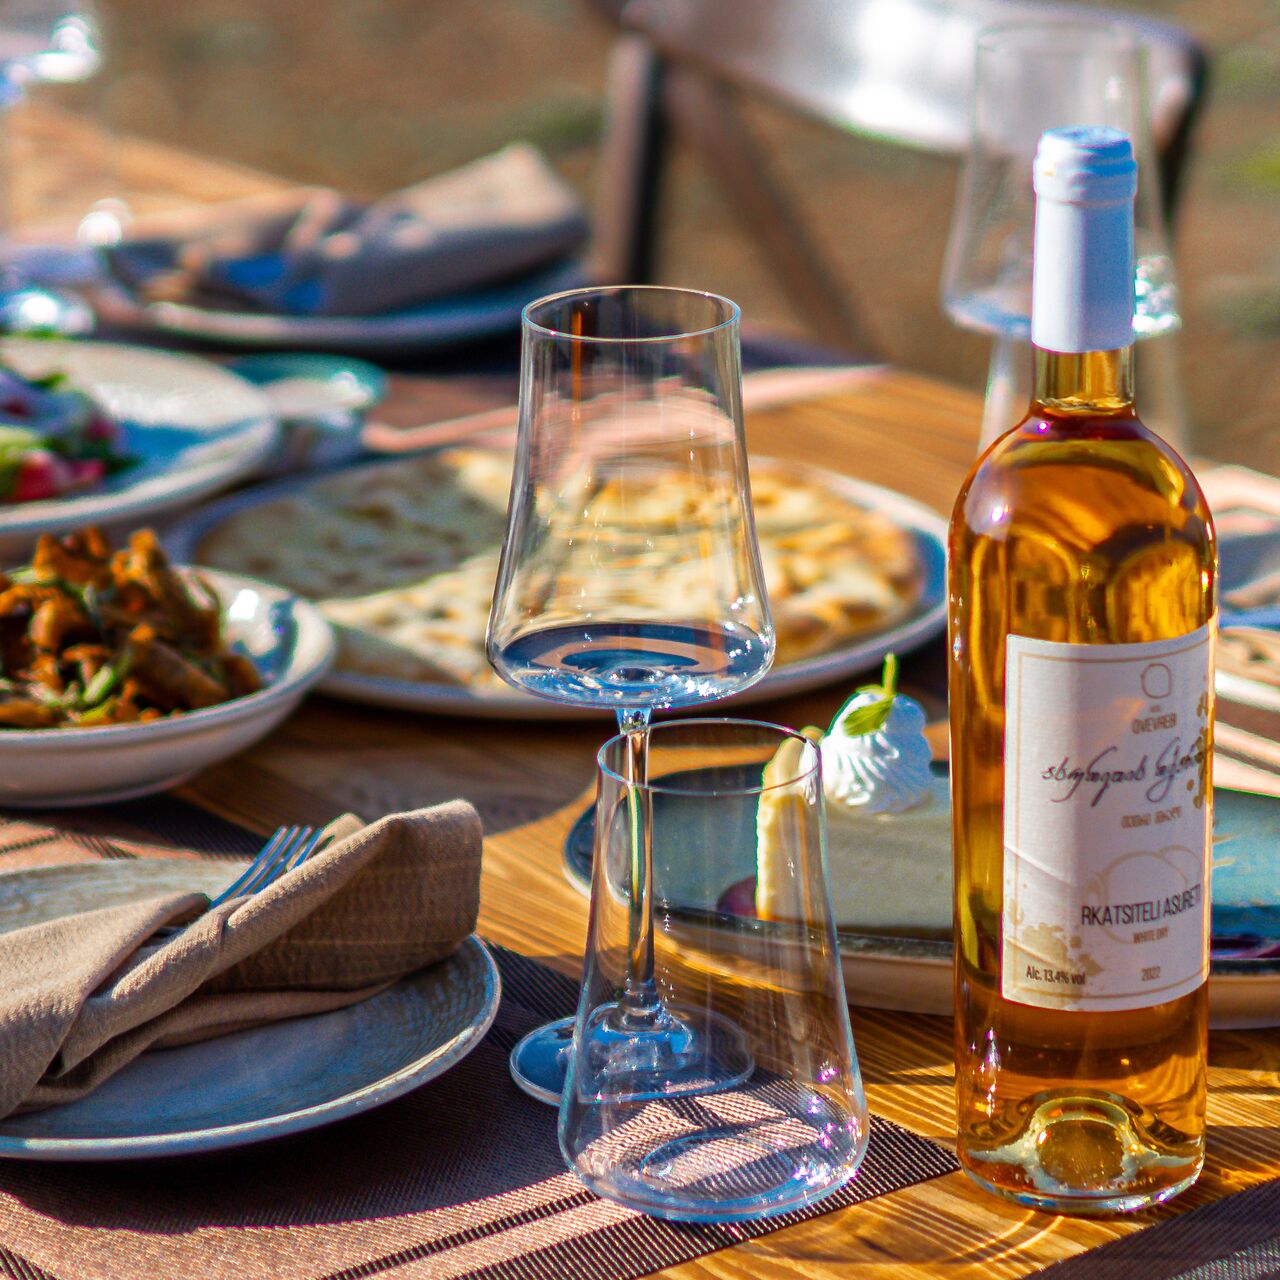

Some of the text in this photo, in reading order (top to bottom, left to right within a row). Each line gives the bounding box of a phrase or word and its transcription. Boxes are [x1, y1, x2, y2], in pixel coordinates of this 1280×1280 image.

[1081, 900, 1160, 926] RKATSITELI
[1026, 964, 1042, 981] Alc.
[1071, 971, 1086, 985] vol
